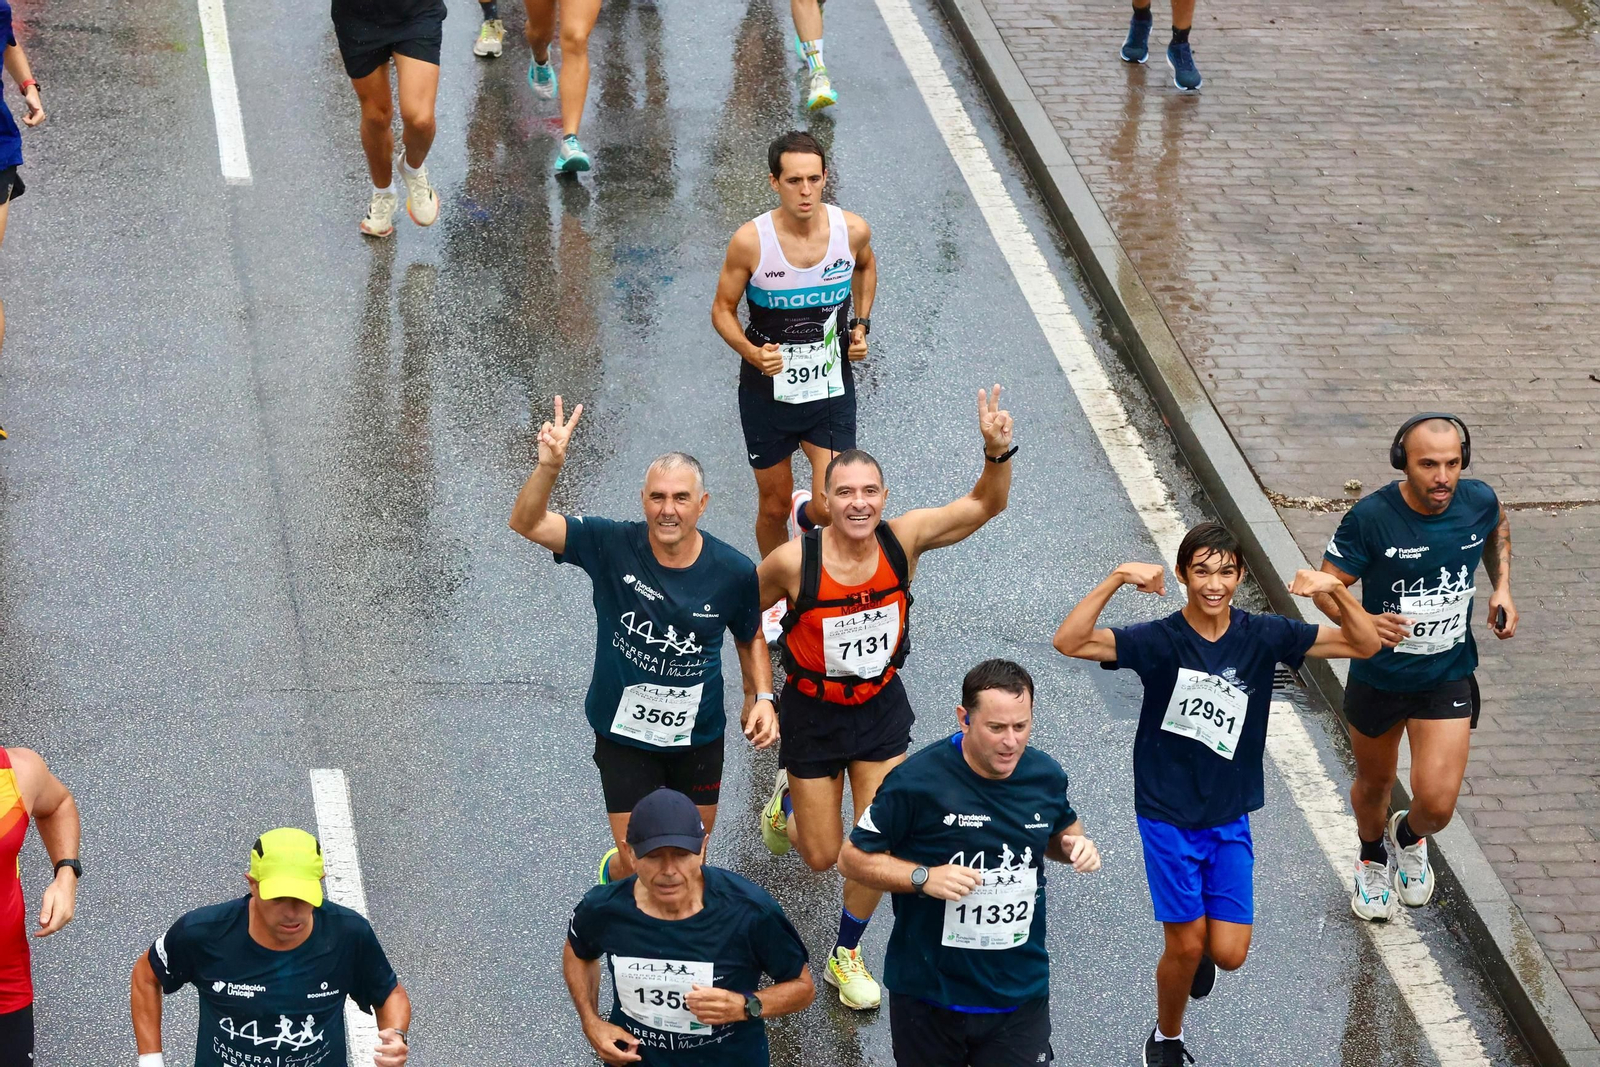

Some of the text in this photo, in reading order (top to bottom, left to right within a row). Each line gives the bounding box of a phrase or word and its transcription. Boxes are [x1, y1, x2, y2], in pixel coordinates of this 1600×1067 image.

[764, 270, 786, 279] vive
[768, 287, 849, 308] inacua
[1398, 546, 1430, 554] Fundación
[1398, 552, 1422, 560] Unicaja
[634, 585, 657, 602] Unicaja
[636, 580, 664, 601] Fundación
[1413, 613, 1461, 638] 6772
[612, 640, 657, 674] URBANA
[613, 632, 659, 665] CARRERA
[838, 633, 888, 661] 7131
[632, 704, 689, 728] 3565
[1178, 697, 1236, 735] 12951
[958, 813, 992, 822] Fundación
[958, 819, 984, 828] Unicaja
[955, 900, 1029, 925] 11332
[227, 982, 266, 993] Fundación
[227, 989, 255, 998] Unicaja
[213, 1036, 272, 1064] CARRERA
